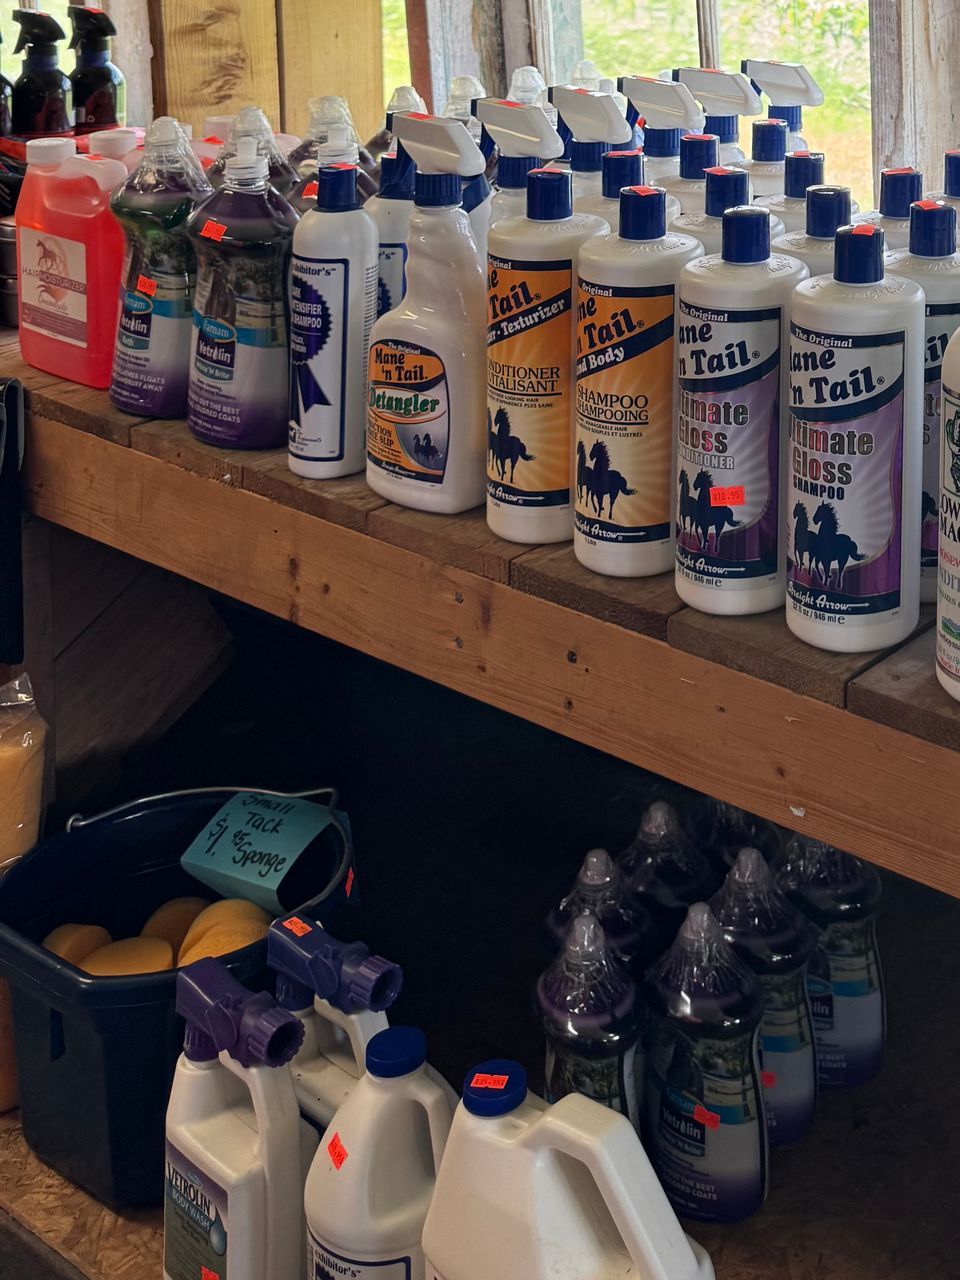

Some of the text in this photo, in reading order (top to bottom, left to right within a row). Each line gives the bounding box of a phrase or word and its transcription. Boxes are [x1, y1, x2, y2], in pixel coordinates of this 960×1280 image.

[582, 282, 613, 297] Original
[501, 298, 565, 336] Texturizer
[690, 309, 728, 322] Original
[795, 328, 853, 348] The Original
[375, 348, 405, 365] Mane
[388, 342, 420, 355] The Original
[589, 345, 625, 370] Body
[140, 374, 165, 384] FLOATS
[395, 365, 424, 381] Tail
[143, 383, 164, 392] AWAY
[578, 383, 648, 409] SHAMPOO
[210, 402, 240, 415] THE BEST
[369, 386, 440, 416] Detangler
[578, 398, 648, 421] SHAMPOOING
[218, 413, 240, 423] COATS
[792, 446, 852, 486] Gloss
[713, 492, 740, 501] $18.95
[793, 475, 845, 500] SHAMPOO
[592, 523, 618, 538] Arrow
[788, 581, 849, 611] Straight Arrow
[814, 611, 836, 623] 946 ml
[242, 794, 296, 814] Small
[245, 811, 285, 834] Tack
[232, 841, 286, 878] Sponge
[167, 1161, 211, 1217] VETROLIN
[190, 1207, 210, 1231] WASH
